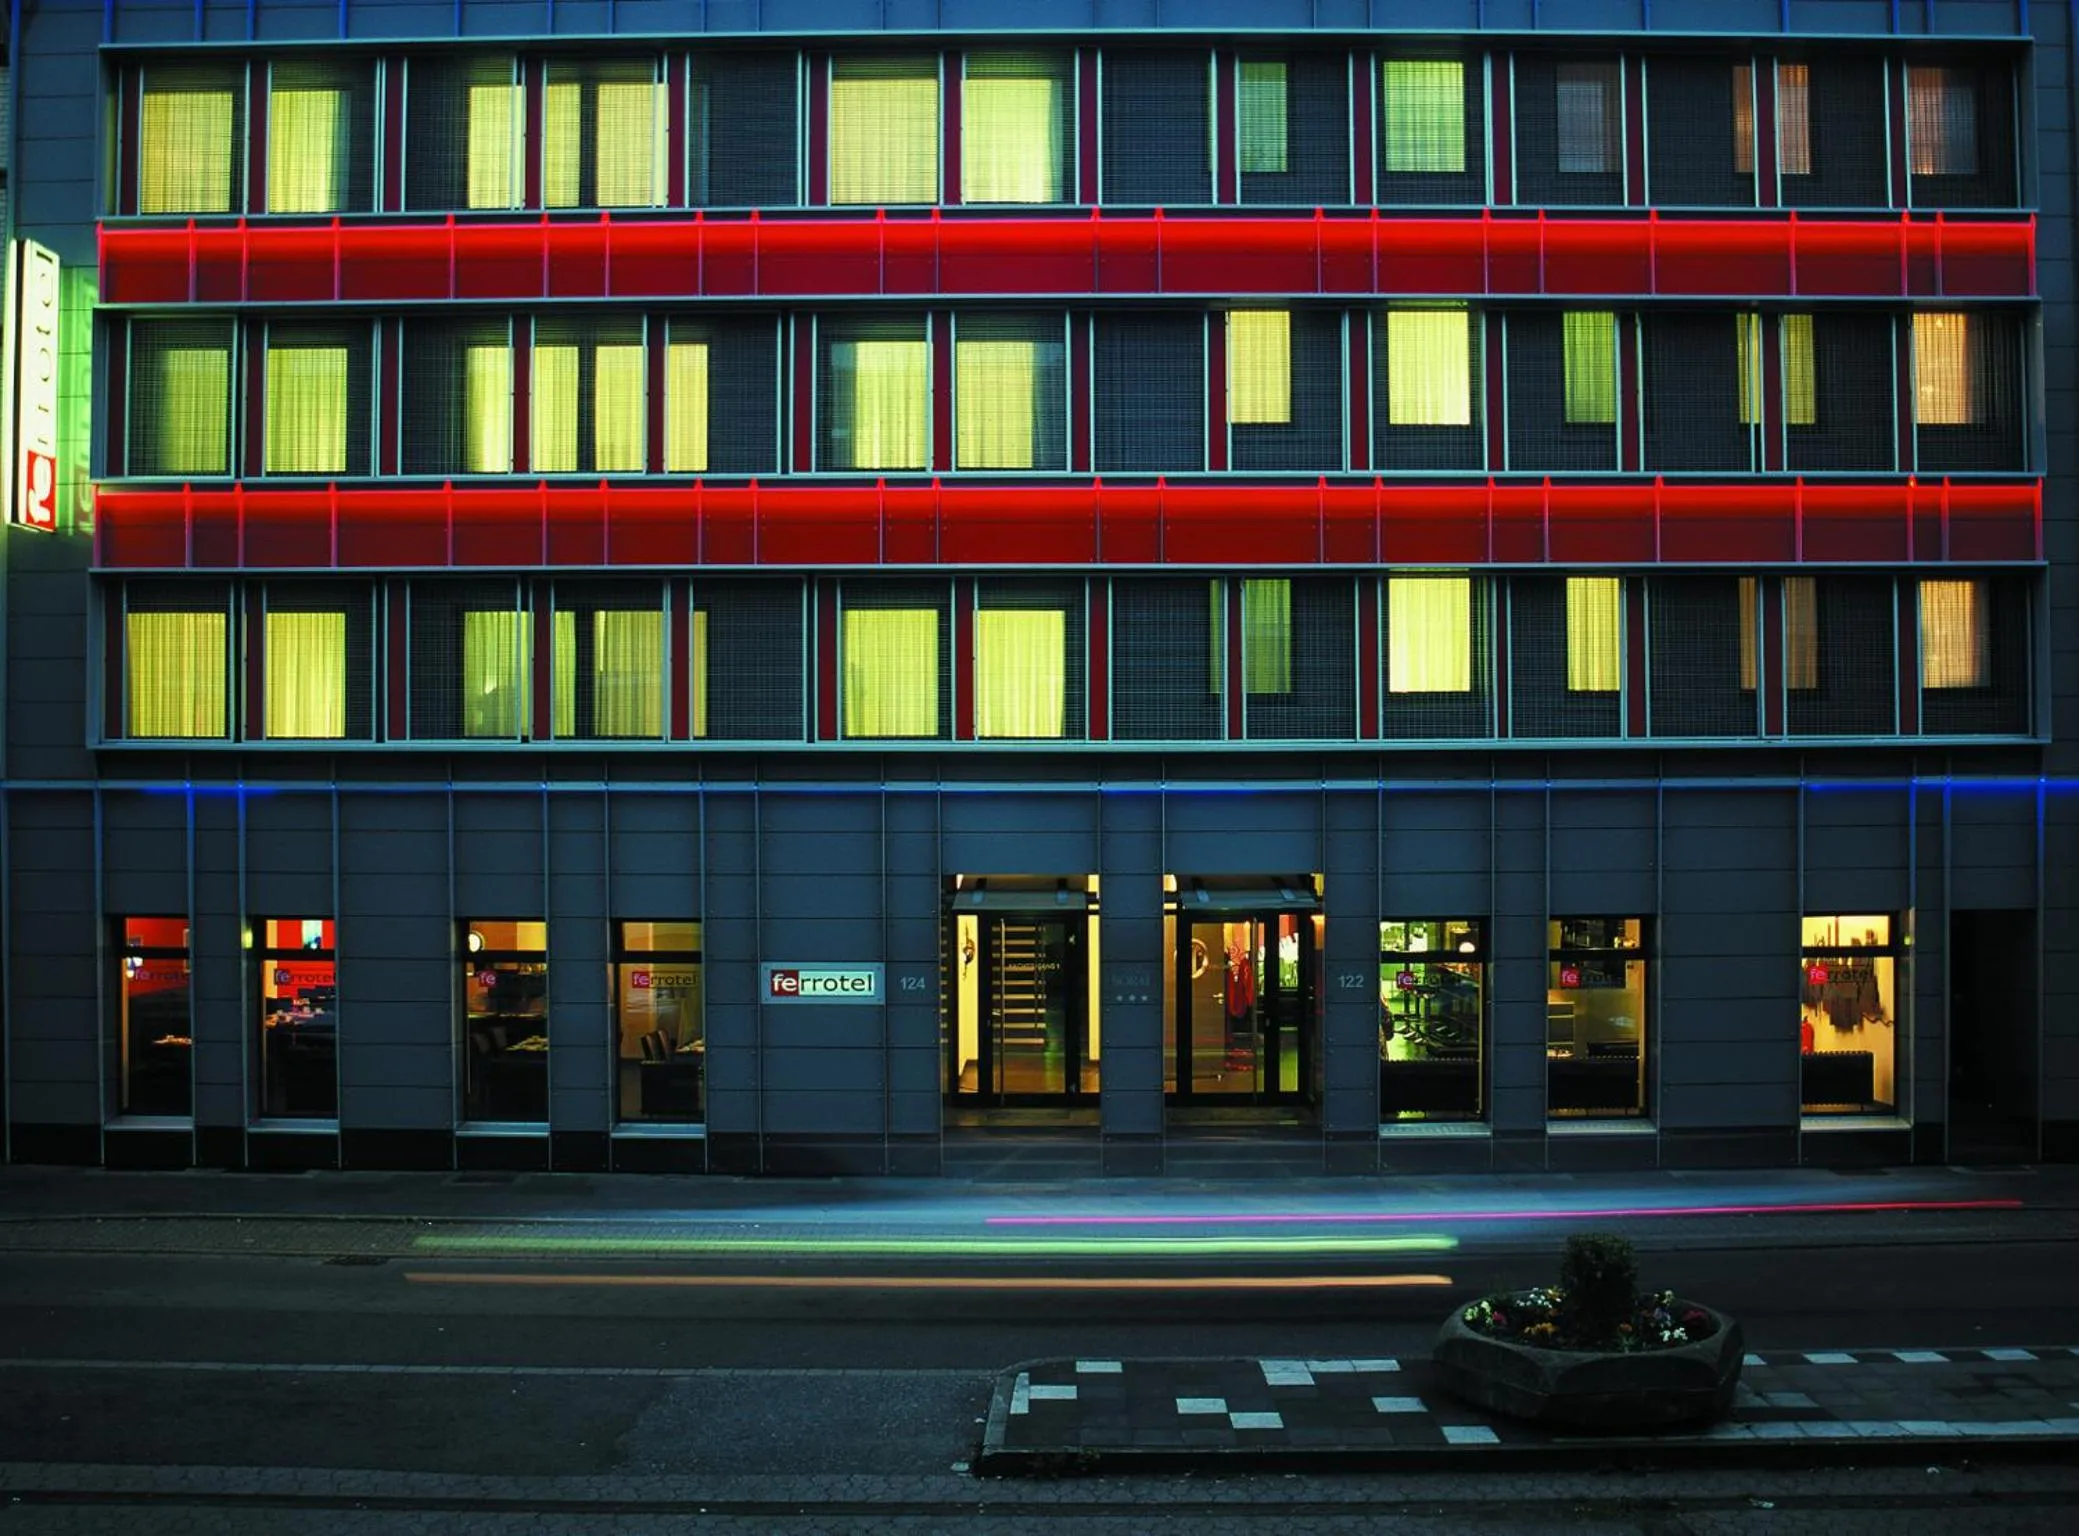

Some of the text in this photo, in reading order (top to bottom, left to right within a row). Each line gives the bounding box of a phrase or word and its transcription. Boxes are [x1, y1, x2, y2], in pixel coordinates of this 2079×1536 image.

[634, 972, 696, 985] ferrotel
[772, 973, 872, 992] ferrotel
[900, 976, 926, 991] 124
[1338, 975, 1364, 988] 122
